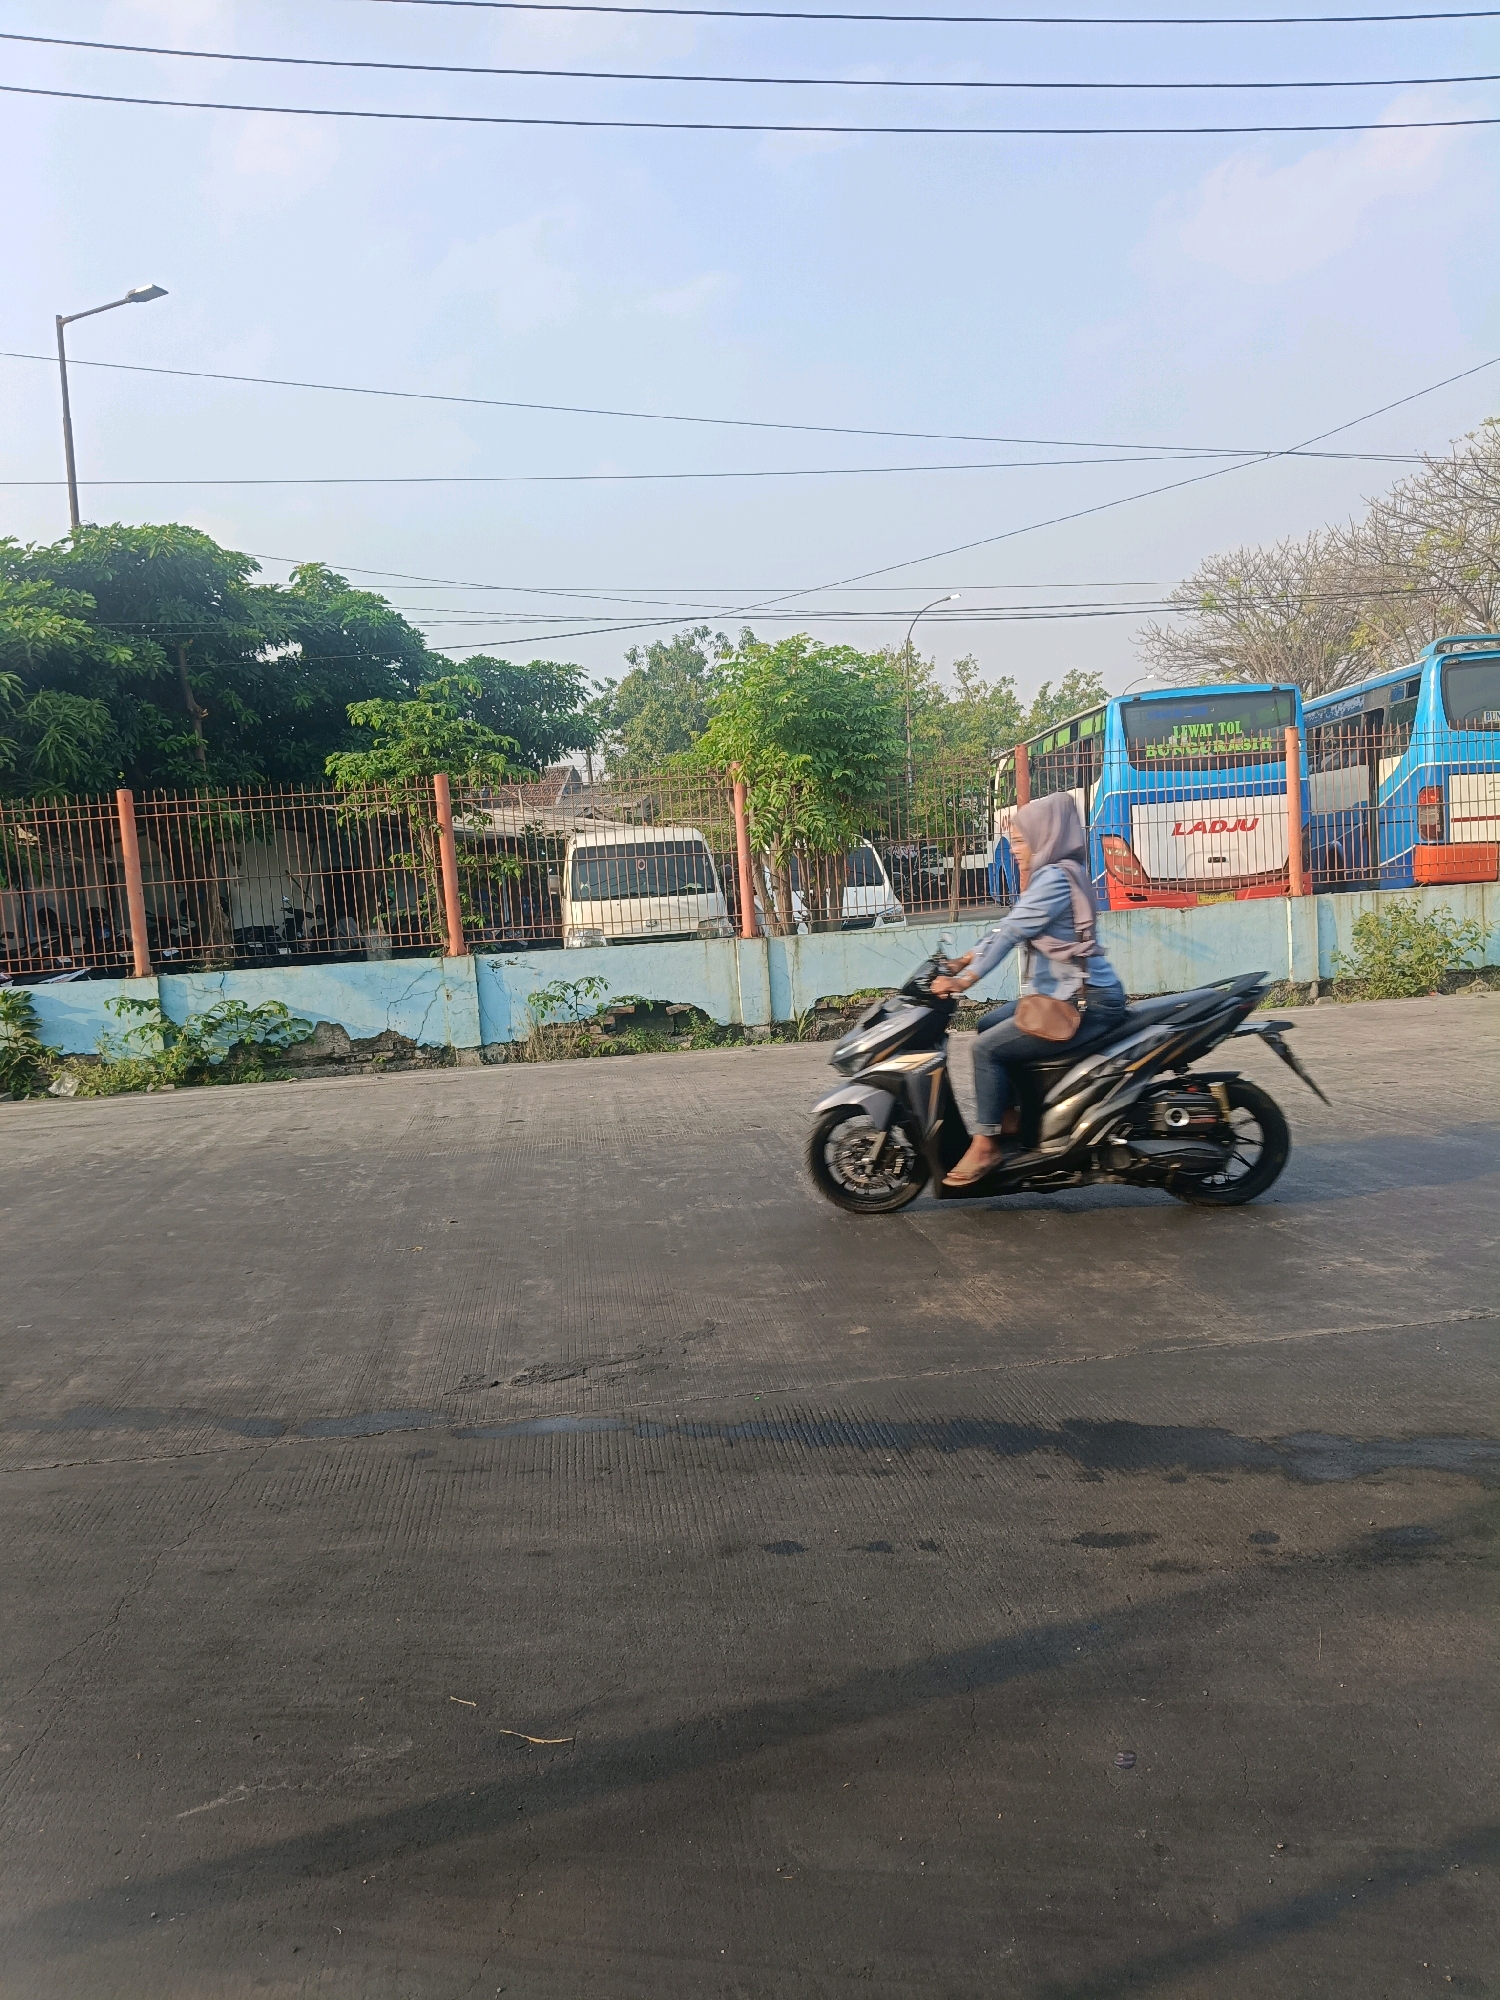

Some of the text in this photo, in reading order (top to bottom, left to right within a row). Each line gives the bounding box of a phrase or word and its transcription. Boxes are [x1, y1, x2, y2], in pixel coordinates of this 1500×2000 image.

[1172, 720, 1243, 739] LEWAT TOL
[1171, 817, 1260, 837] LADJU
